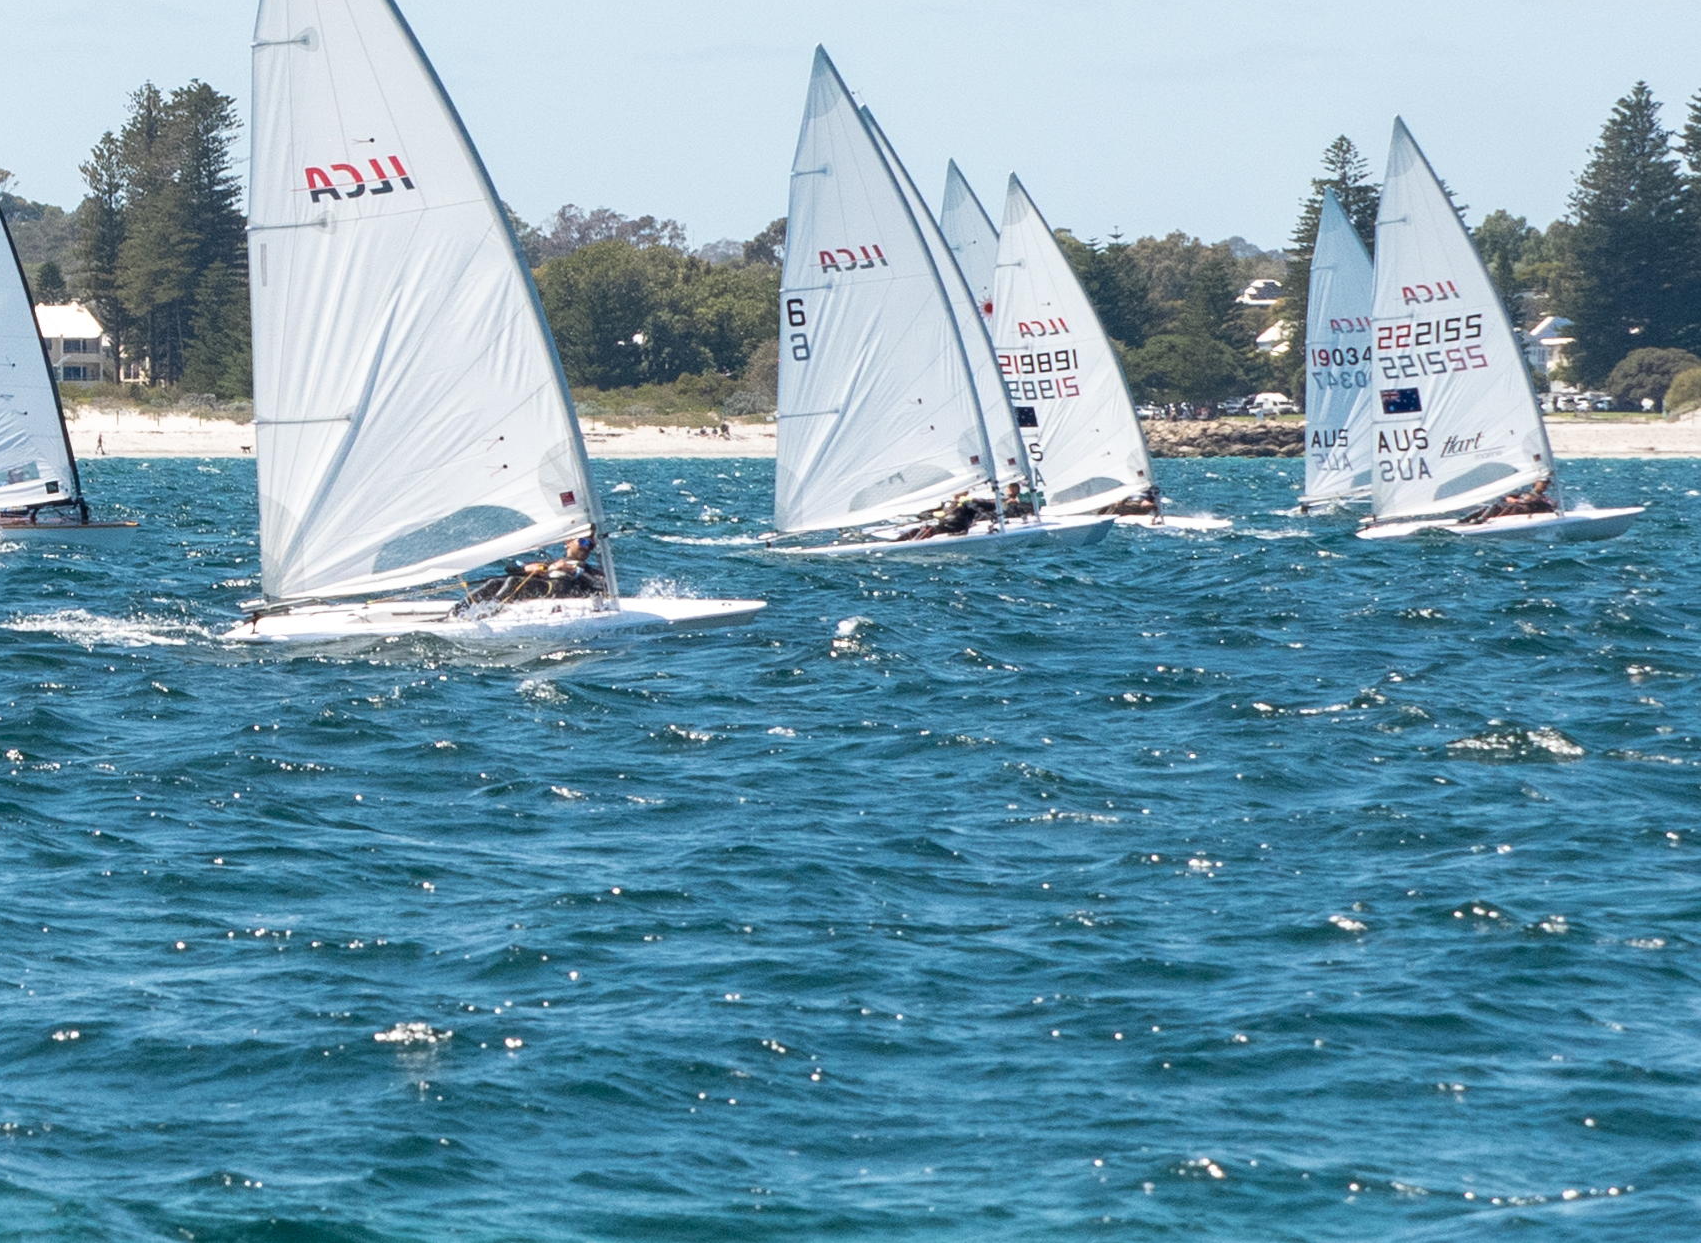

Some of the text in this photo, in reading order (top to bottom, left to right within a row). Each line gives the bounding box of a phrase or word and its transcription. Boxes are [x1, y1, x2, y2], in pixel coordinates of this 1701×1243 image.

[786, 298, 806, 327] 6
[1377, 313, 1482, 350] 222155
[998, 349, 1078, 374] 219891
[1311, 346, 1372, 367] 19034
[1311, 428, 1349, 448] AUS
[1378, 428, 1429, 453] AUS
[1440, 431, 1485, 458] Hart
